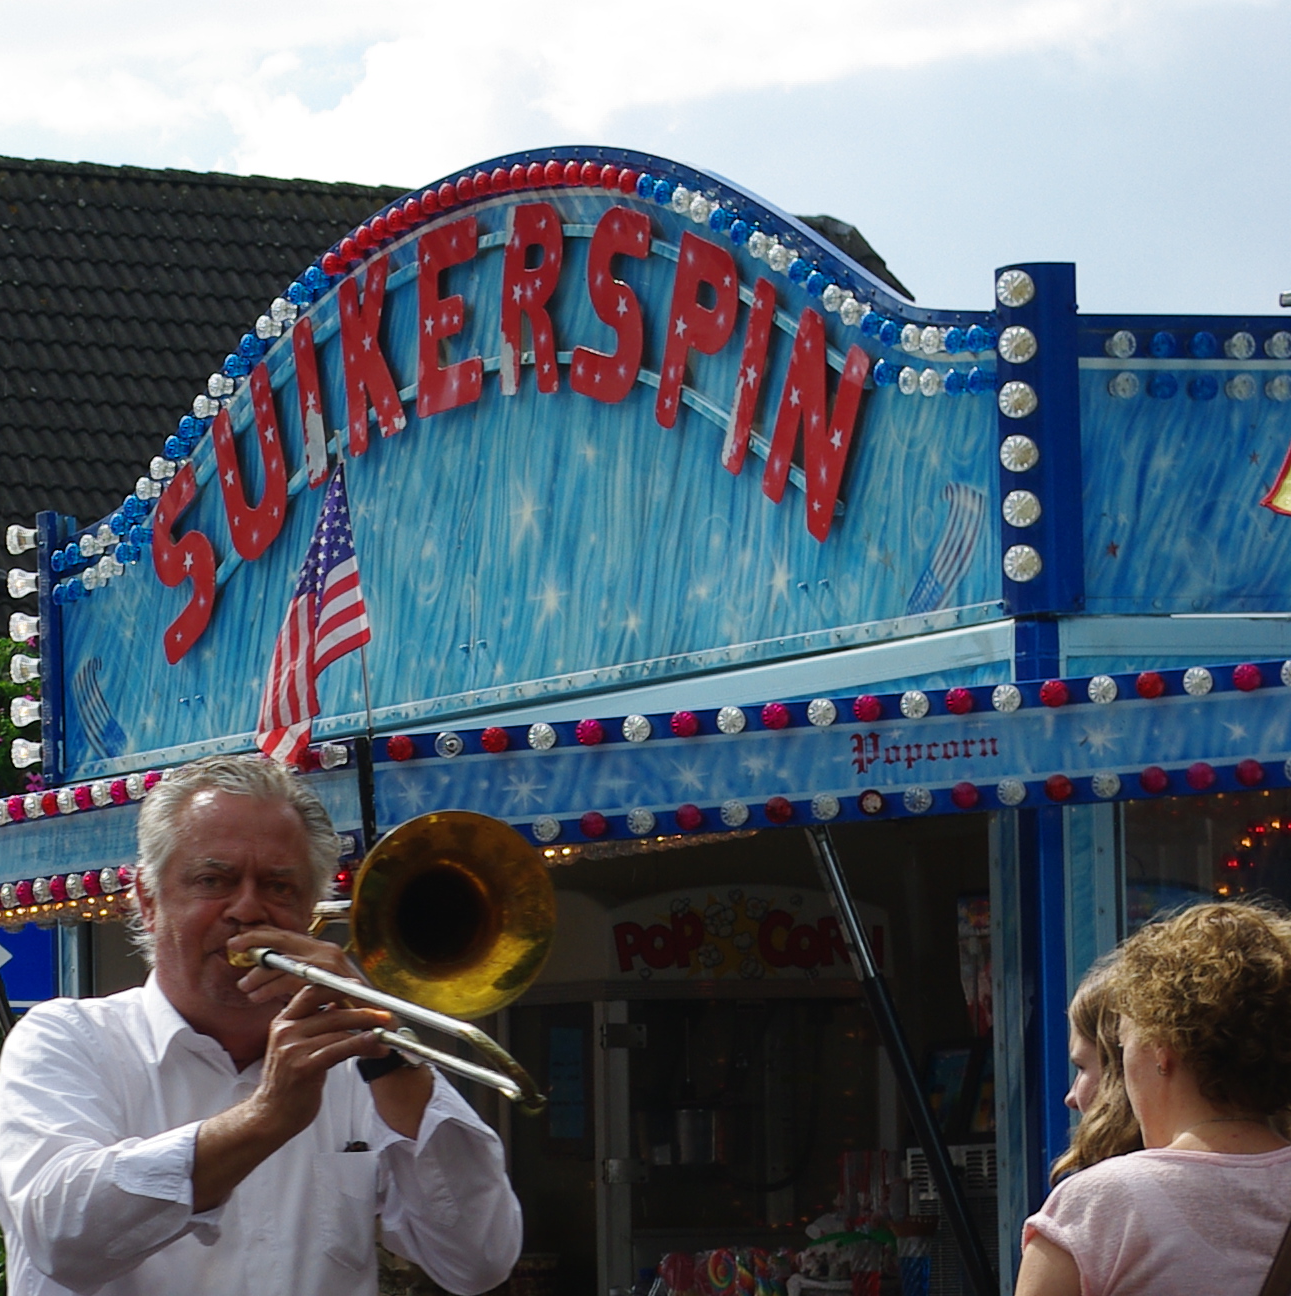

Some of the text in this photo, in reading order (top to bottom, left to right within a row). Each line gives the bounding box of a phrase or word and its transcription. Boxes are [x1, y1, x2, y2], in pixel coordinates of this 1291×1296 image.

[152, 201, 870, 665] SUIKERSPIN
[849, 731, 999, 775] Popcorn
[612, 910, 704, 973] POP
